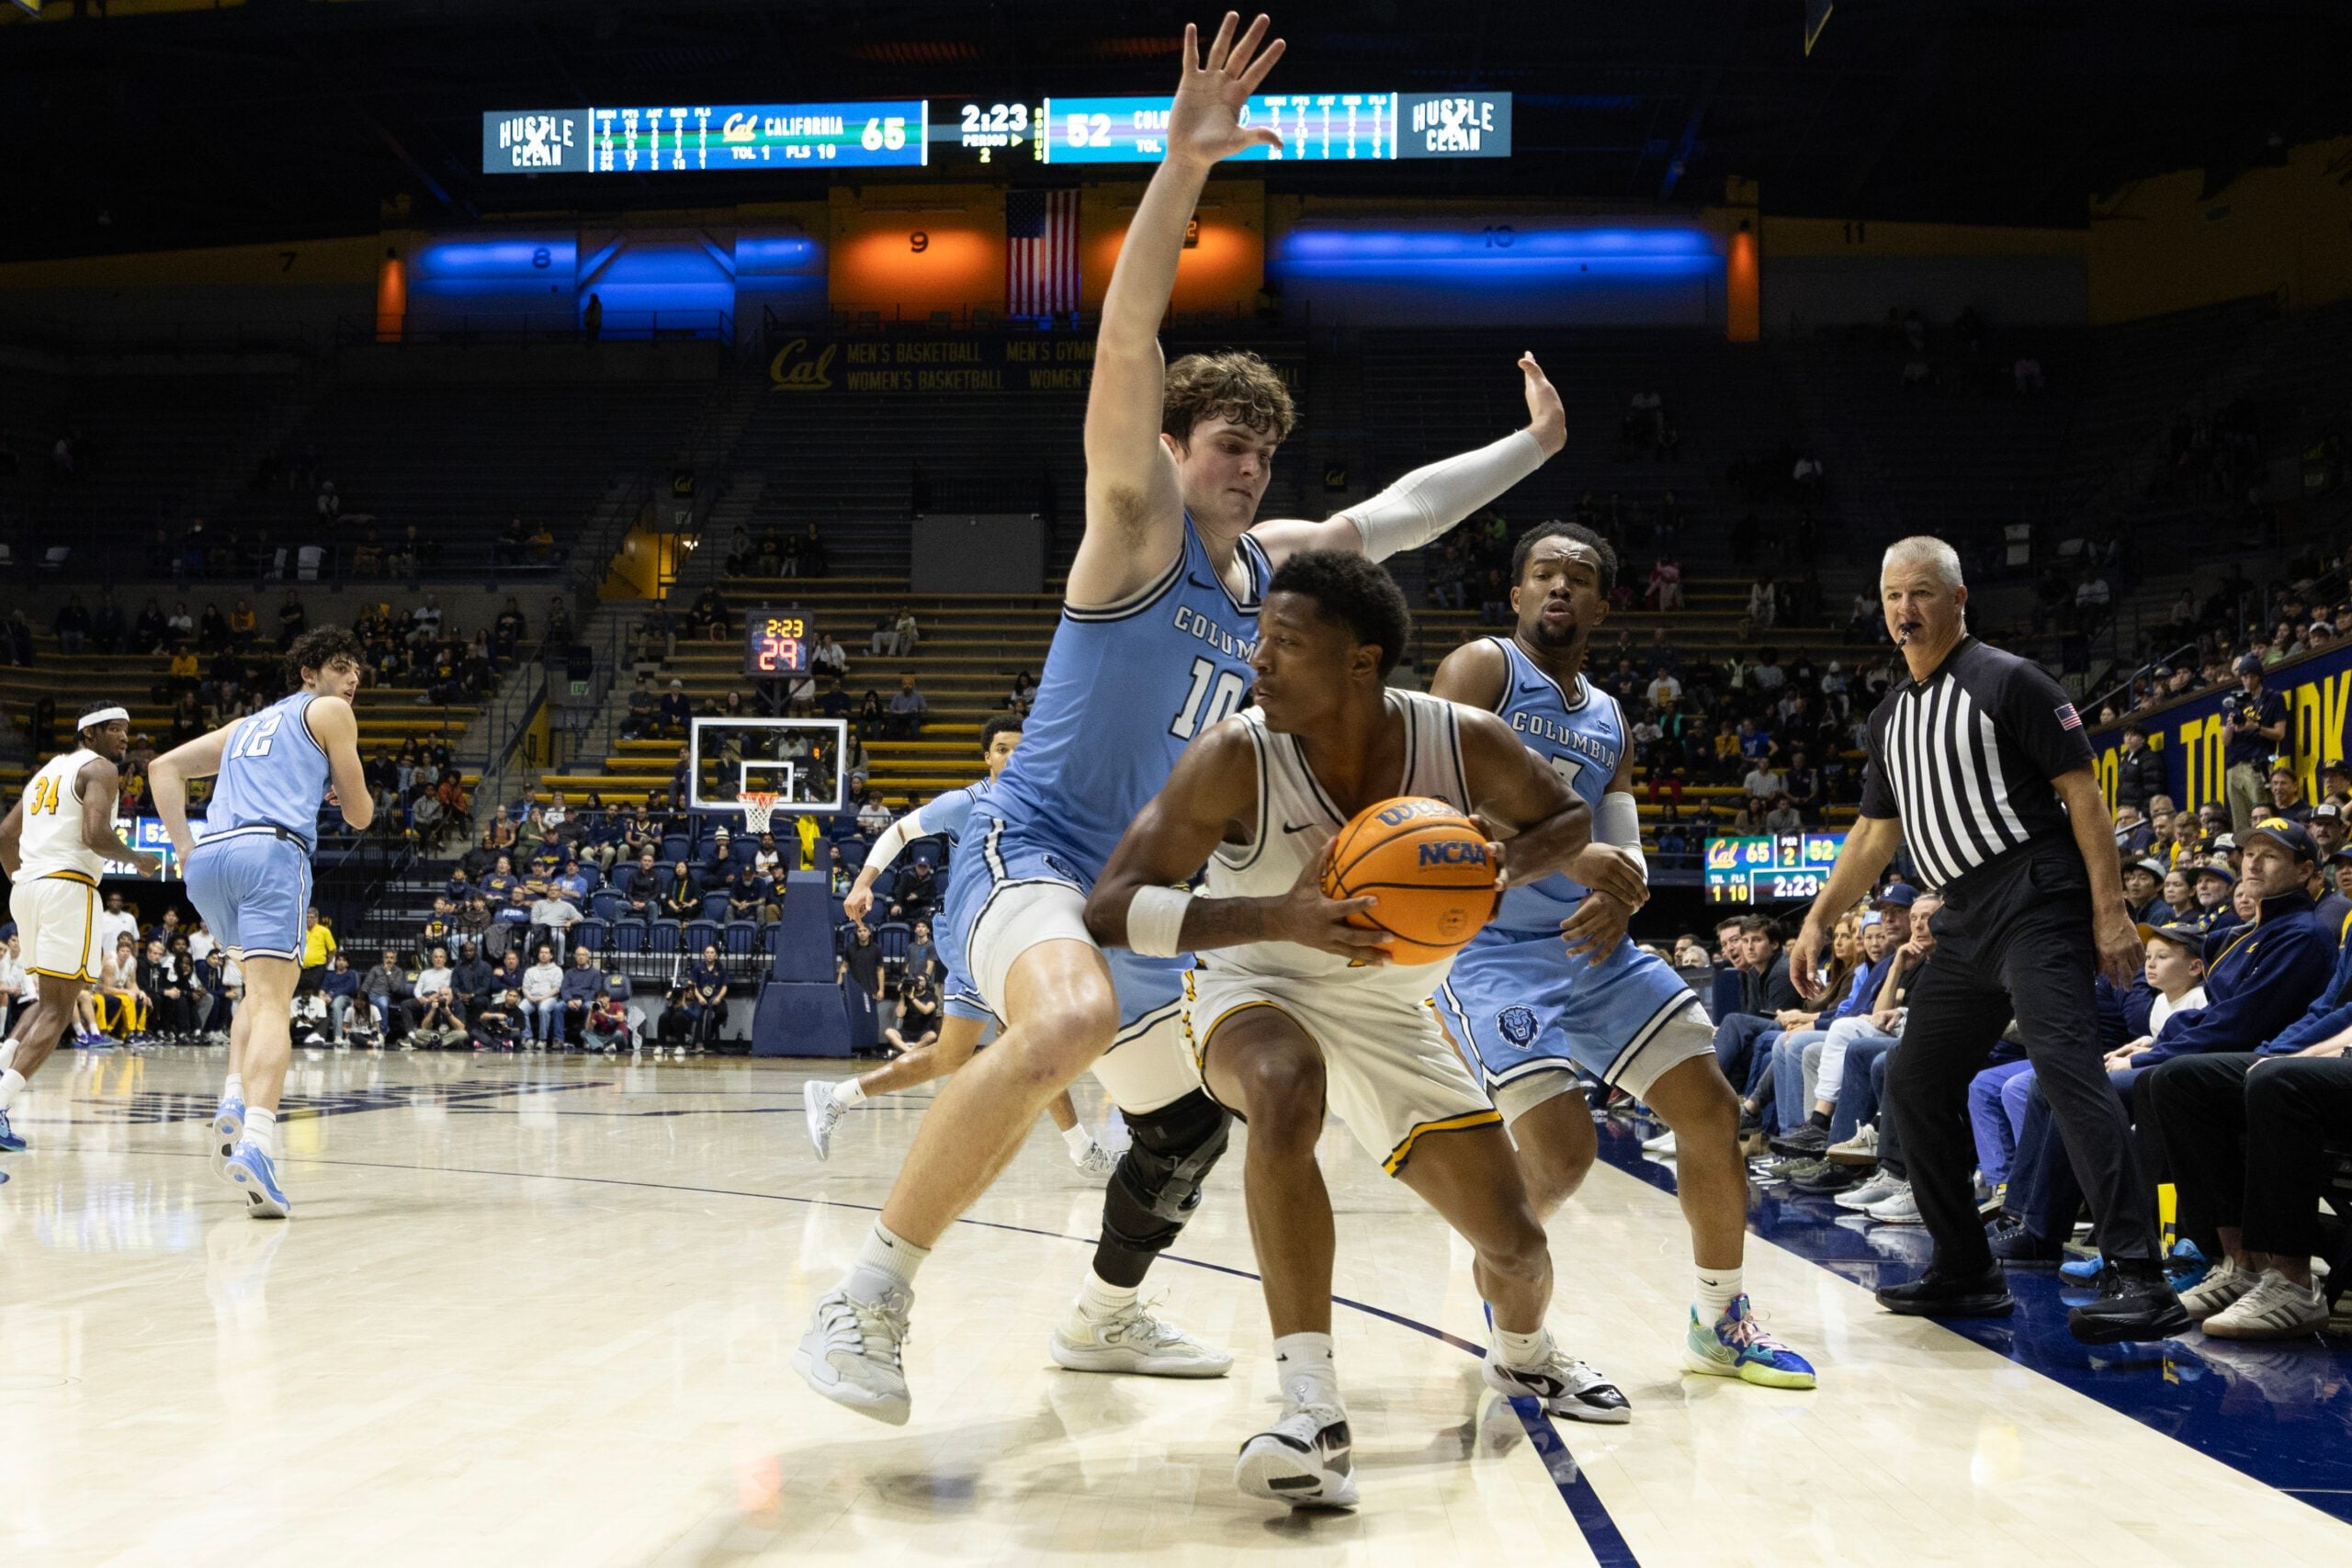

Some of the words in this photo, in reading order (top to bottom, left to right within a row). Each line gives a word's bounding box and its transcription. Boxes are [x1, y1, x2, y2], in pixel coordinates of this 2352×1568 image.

[961, 104, 1028, 132] 2:23
[1413, 98, 1495, 132] HUSTLE
[499, 115, 574, 149] HUSTLE
[723, 112, 758, 142] Cal
[764, 117, 843, 136] CALIFORNIA
[861, 117, 906, 151] 65
[1067, 113, 1112, 148] 52
[962, 134, 1008, 147] PERIOD
[1136, 139, 1162, 152] TOL
[731, 146, 756, 160] TOL
[761, 145, 770, 160] 1
[786, 145, 810, 158] FLS
[817, 144, 836, 159] 10
[979, 147, 990, 164] 2
[910, 231, 928, 253] 9
[1484, 224, 1516, 248] 10
[1844, 221, 1864, 243] 11
[278, 252, 297, 273] 7
[532, 247, 550, 269] 8
[847, 344, 889, 364] MEN'S
[897, 343, 981, 363] BASKETBALL
[1006, 342, 1049, 362] MEN'S
[770, 338, 837, 391] Cal
[847, 371, 911, 391] WOMEN'S
[919, 370, 1004, 390] BASKETBALL
[765, 618, 804, 638] 2:23
[759, 639, 797, 671] 29
[1168, 655, 1244, 742] 10
[229, 711, 283, 761] 12
[1511, 711, 1617, 772] COLUMBIA
[30, 775, 62, 816] 34
[1781, 837, 1798, 847] PER
[1809, 840, 1835, 862] 52
[1418, 840, 1487, 867] NCAA
[1708, 839, 1739, 870] Cal
[1746, 842, 1770, 863] 65
[1783, 847, 1795, 866] 2
[1710, 874, 1724, 884] TOL
[1731, 874, 1746, 884] FLS
[1773, 874, 1818, 897] 2:23
[1713, 885, 1721, 902] 1
[1729, 885, 1748, 901] 10
